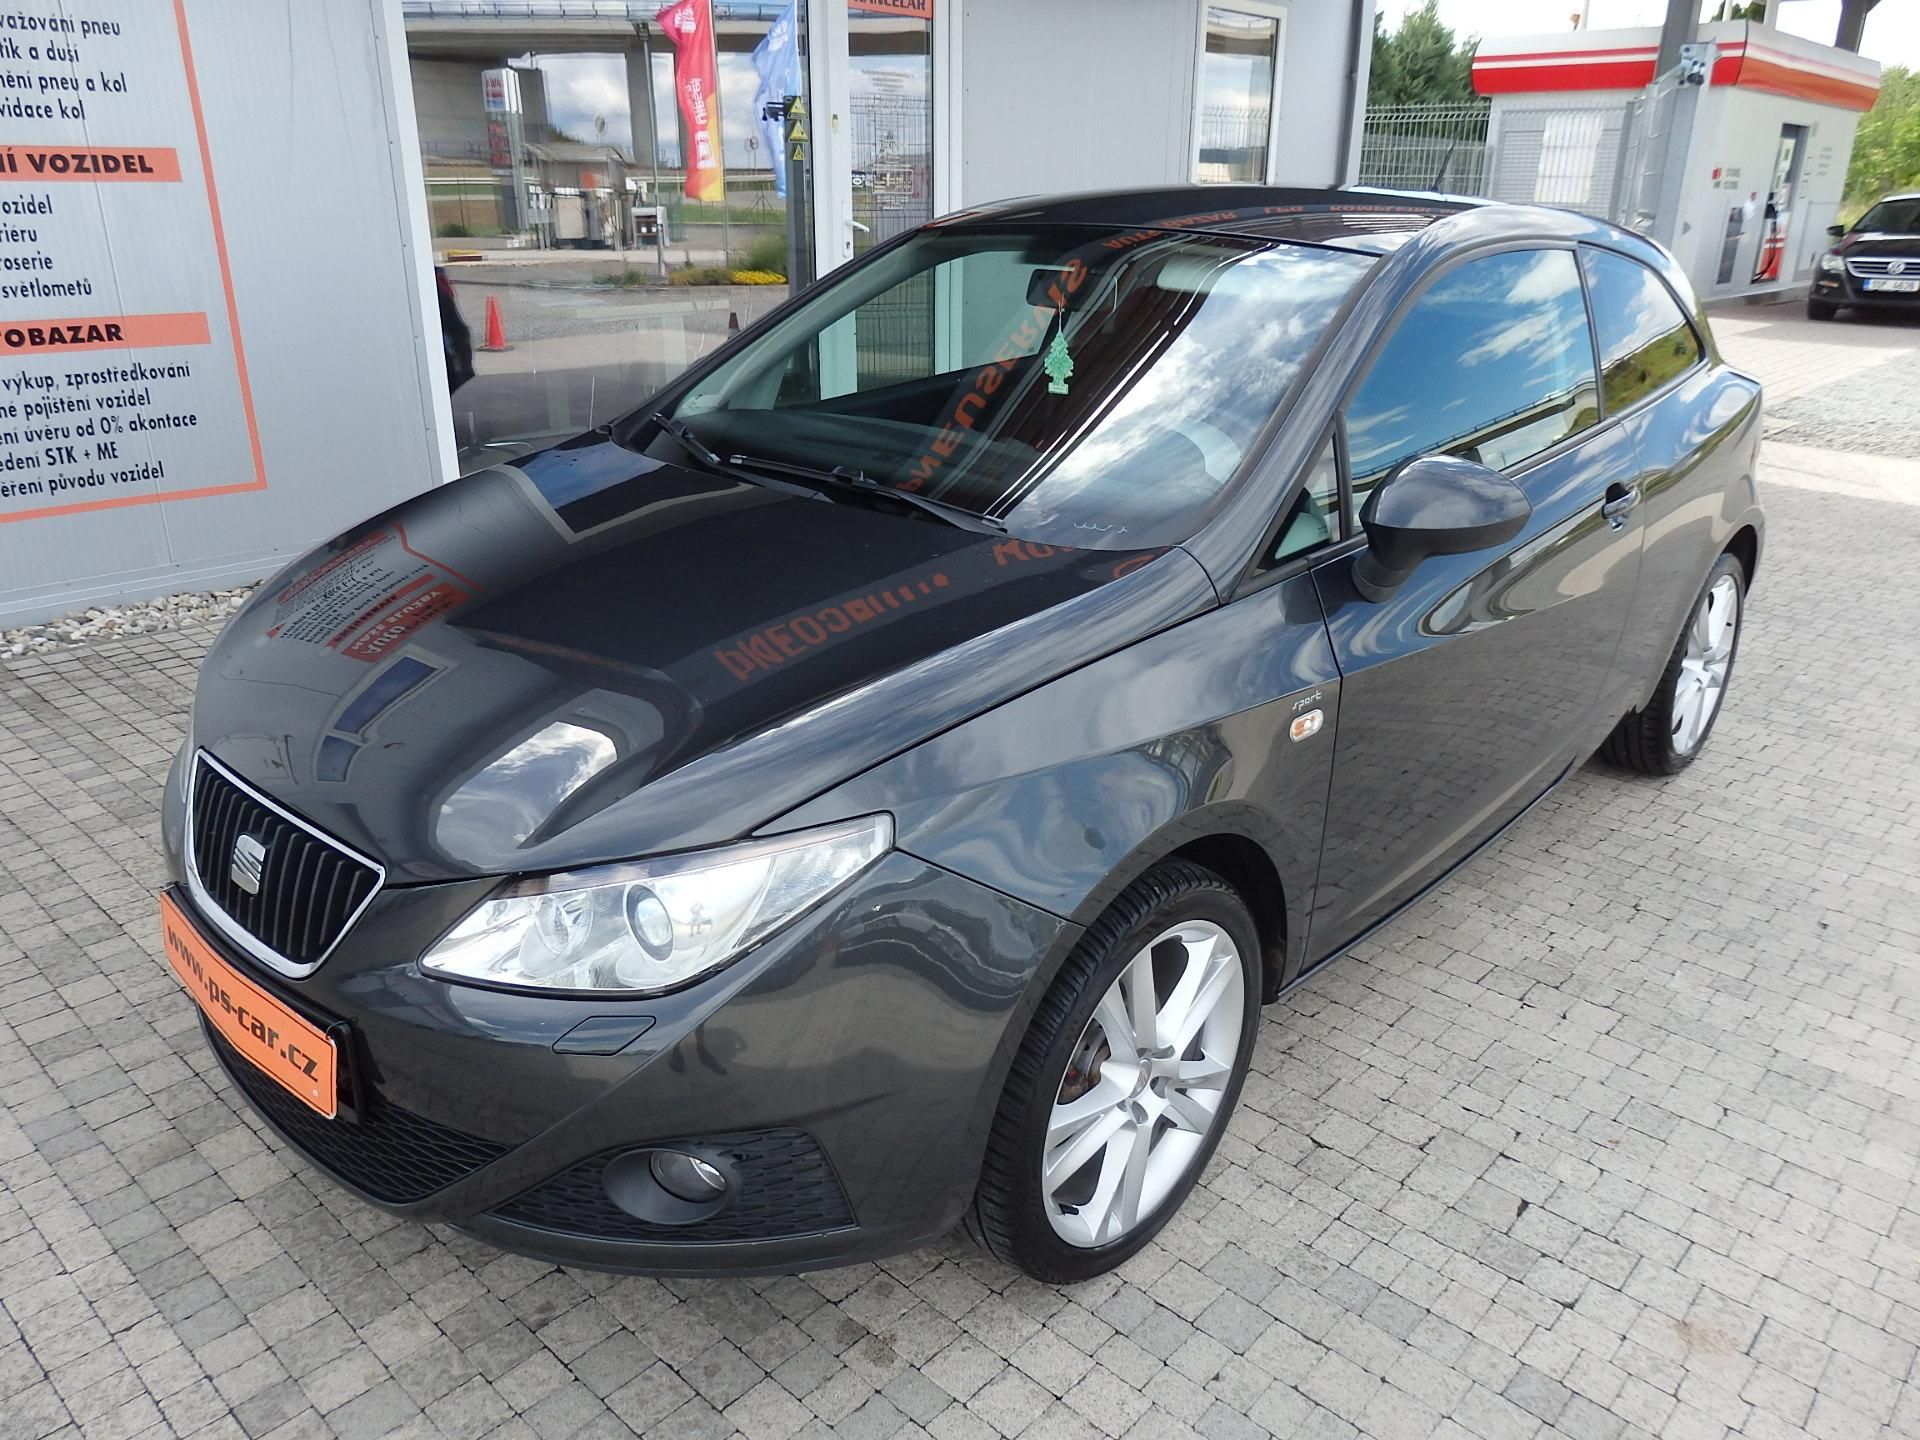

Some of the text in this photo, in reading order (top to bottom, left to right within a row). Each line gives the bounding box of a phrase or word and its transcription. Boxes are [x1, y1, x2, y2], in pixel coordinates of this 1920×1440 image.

[81, 18, 121, 39] pneu
[29, 46, 39, 60] a
[46, 40, 80, 62] duší
[38, 76, 79, 95] pneu
[86, 77, 96, 91] a
[101, 72, 128, 93] kol
[58, 98, 86, 120] kol
[26, 153, 154, 174] VOZIDEL
[2, 194, 53, 215] ozidel
[2, 277, 92, 299] světlometů
[0, 323, 124, 348] OBAZAR
[2, 361, 190, 396] výkup, zprostředkování
[24, 394, 91, 421] pojištění
[96, 387, 151, 409] vozidel
[24, 425, 70, 443] úvěru
[76, 418, 95, 437] od
[100, 415, 123, 434] 0%
[129, 413, 197, 432] akontace
[45, 445, 77, 466] STK
[97, 441, 119, 461] ME
[1, 460, 164, 497] ěření původu vozidel
[1291, 690, 1322, 711] sport
[167, 925, 319, 1083] www.ps-car.cz
